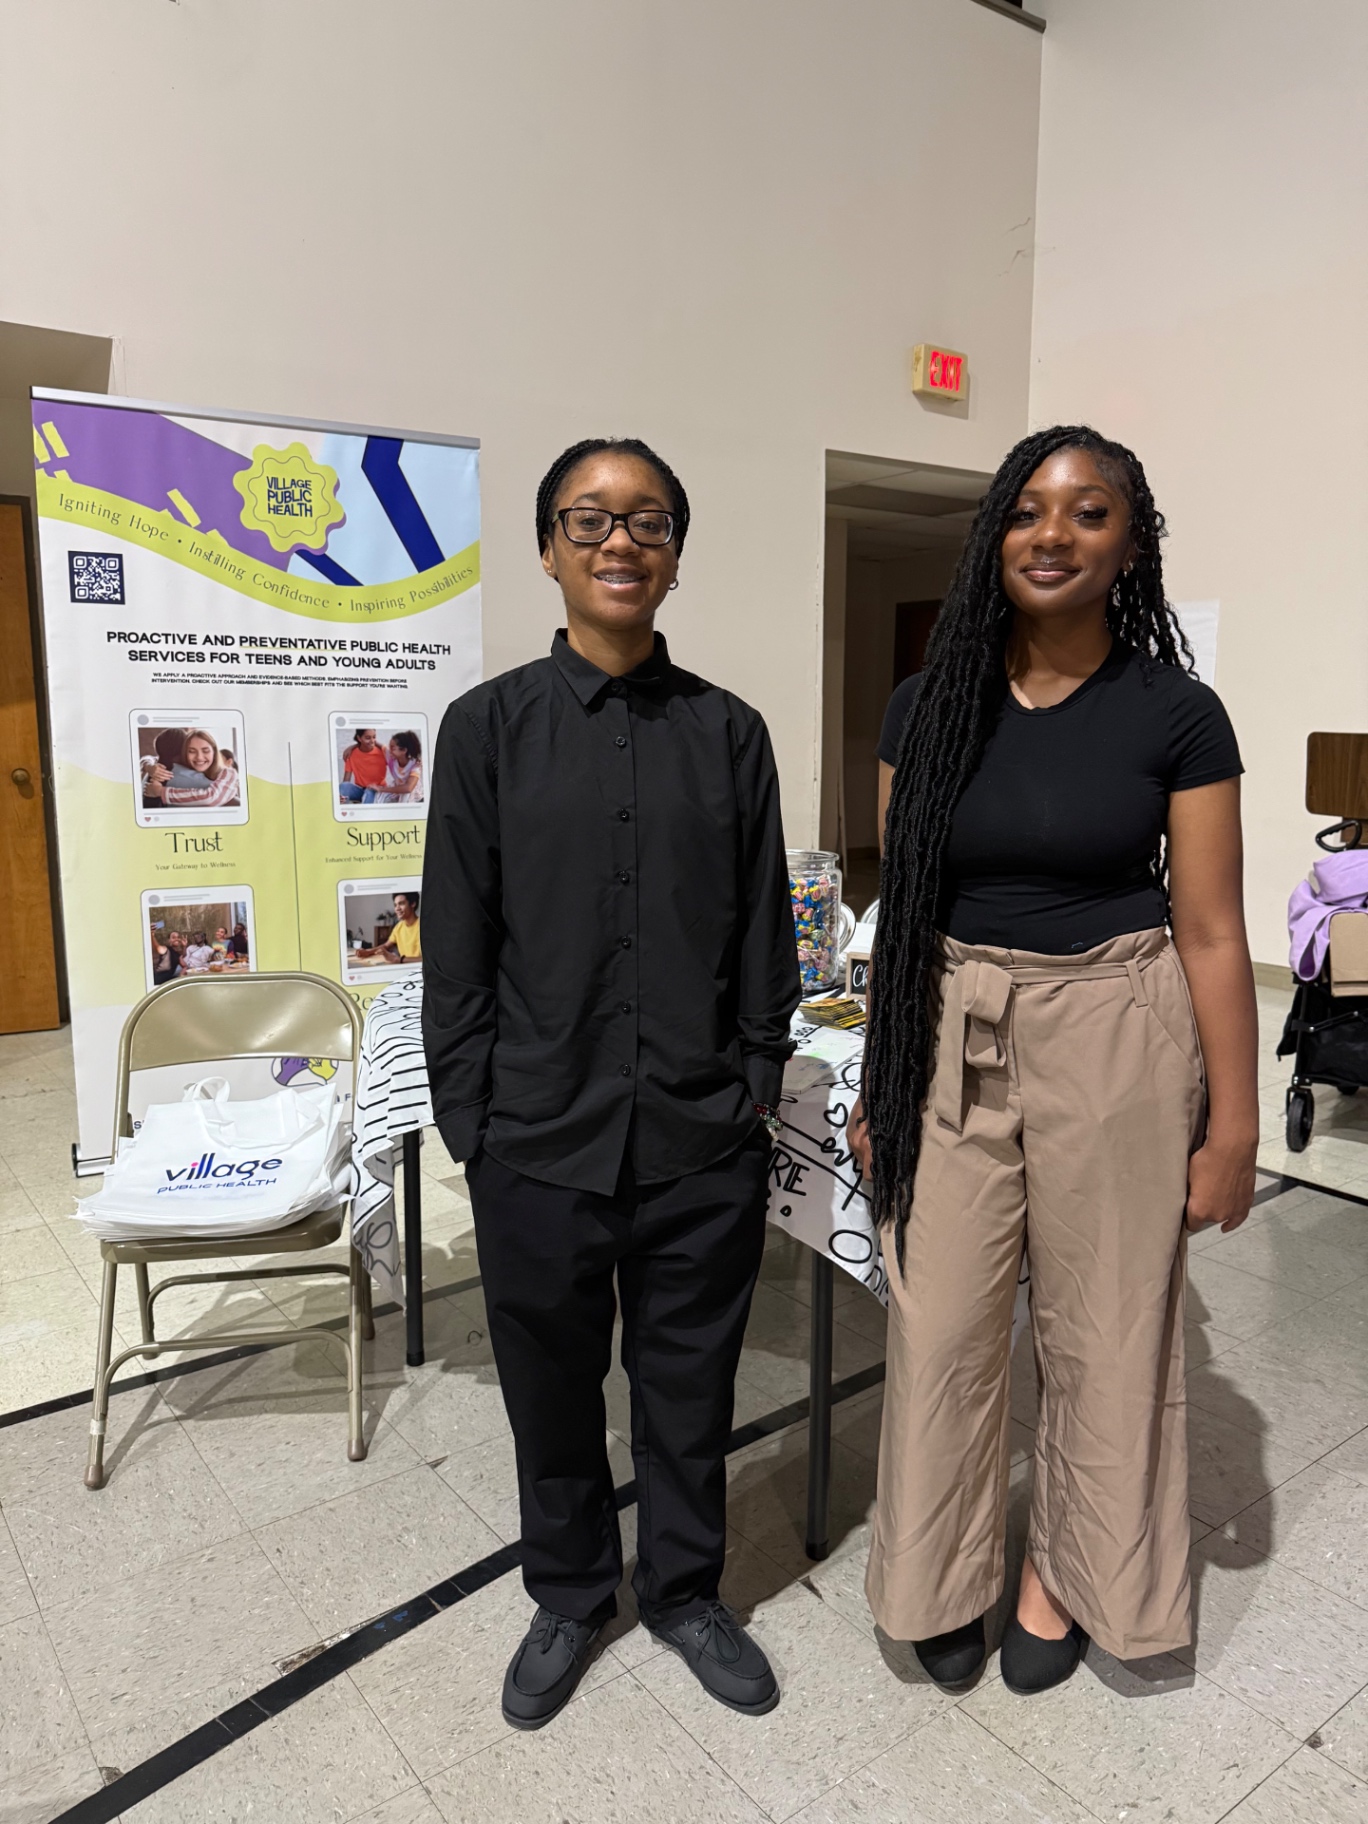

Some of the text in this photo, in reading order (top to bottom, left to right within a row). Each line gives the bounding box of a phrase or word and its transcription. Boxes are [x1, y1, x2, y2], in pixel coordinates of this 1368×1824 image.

[929, 351, 963, 391] EXIT
[266, 476, 312, 490] VILLAGE
[267, 489, 312, 504] PUBLIC
[267, 502, 313, 518] HEALTH
[59, 493, 473, 615] Igniting Hope Instilling Confidence Inspiring Possibilities
[107, 631, 451, 655] PROACTIVE AND PREVENTATIVE PUBLIC HEALTH
[128, 650, 436, 670] SERVICES FOR TEENS AND YOUNG ADULTS
[164, 831, 224, 853] Trust
[346, 825, 421, 851] Support
[155, 863, 170, 871] Your
[166, 1152, 283, 1181] village
[157, 1178, 278, 1194] PUBLIC HEALTH
